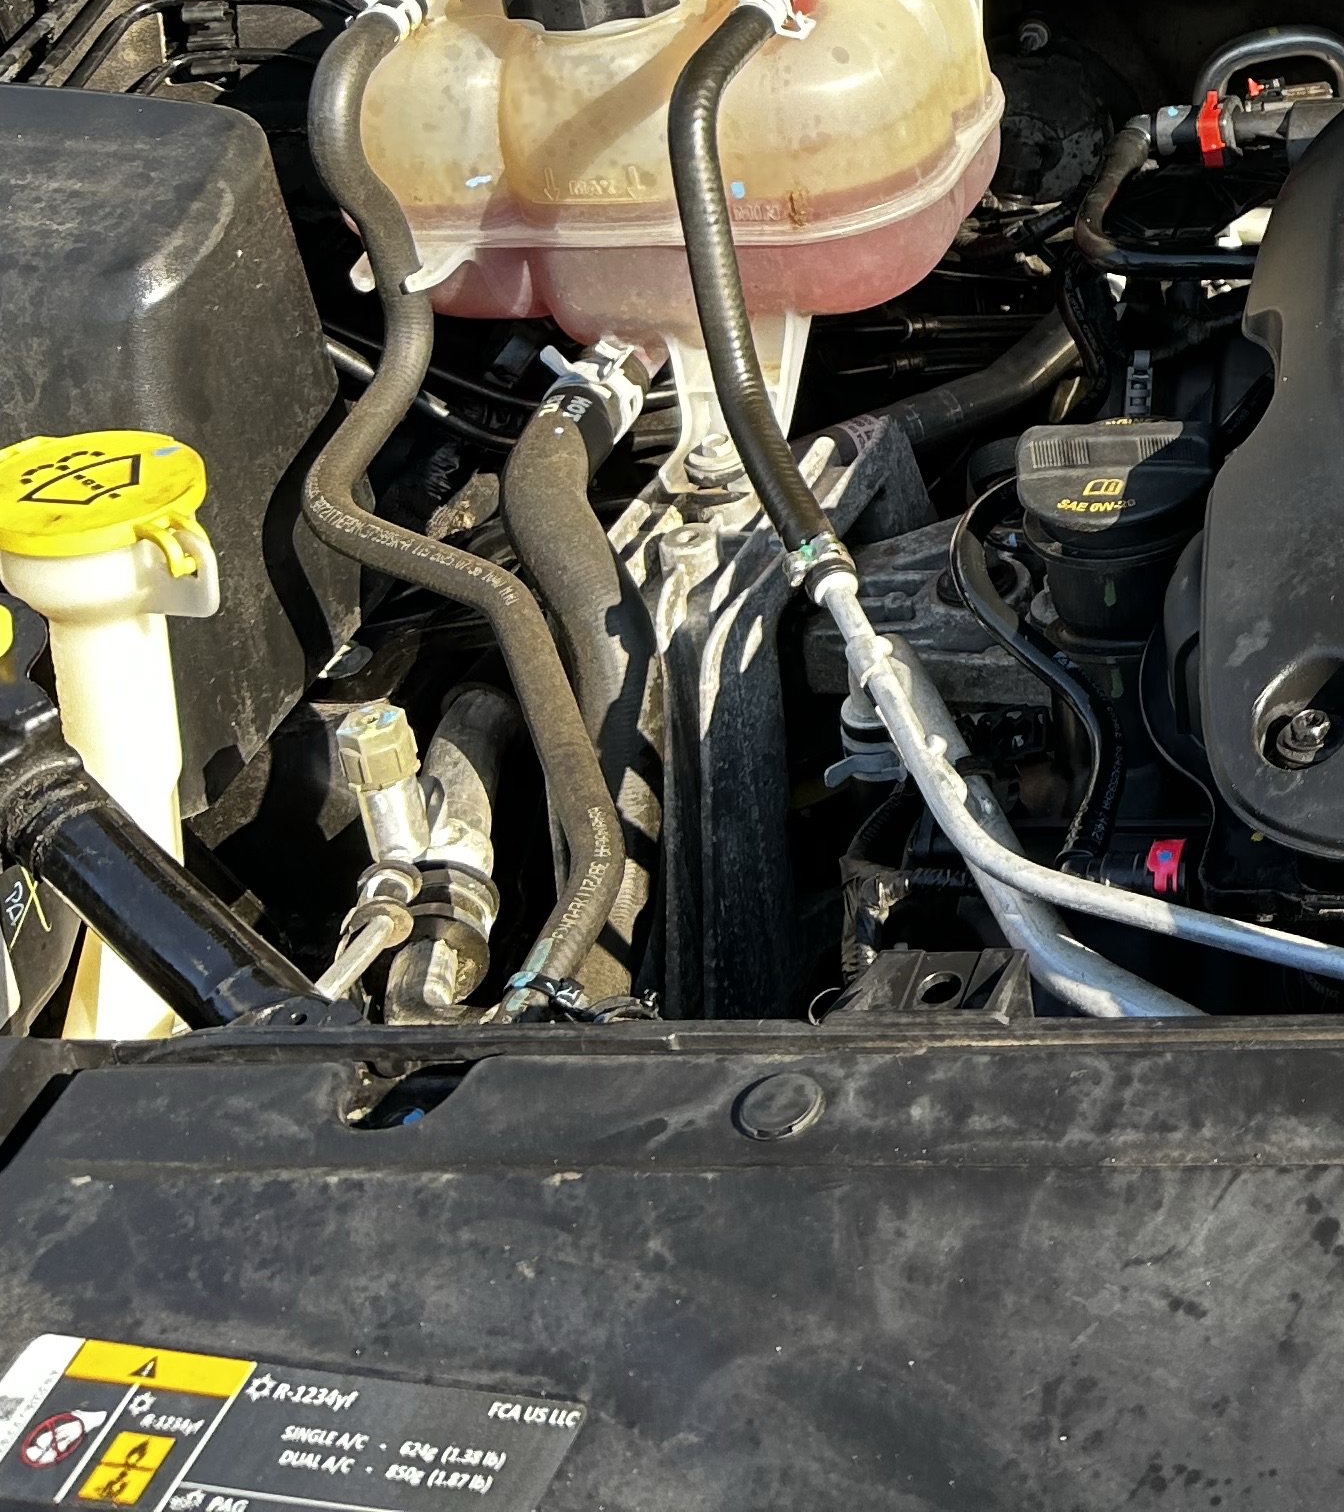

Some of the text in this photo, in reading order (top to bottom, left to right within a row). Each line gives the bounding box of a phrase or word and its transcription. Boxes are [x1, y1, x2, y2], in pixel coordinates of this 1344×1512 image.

[562, 395, 593, 423] HOT
[1056, 498, 1137, 513] SAE 0W-20
[272, 1382, 359, 1412] R-1234yf
[487, 1401, 582, 1428] FCA US LLC
[281, 1425, 338, 1447] SINGLE
[335, 1432, 371, 1451] A/C
[278, 1449, 322, 1470] DUAL
[320, 1455, 356, 1475] A/C
